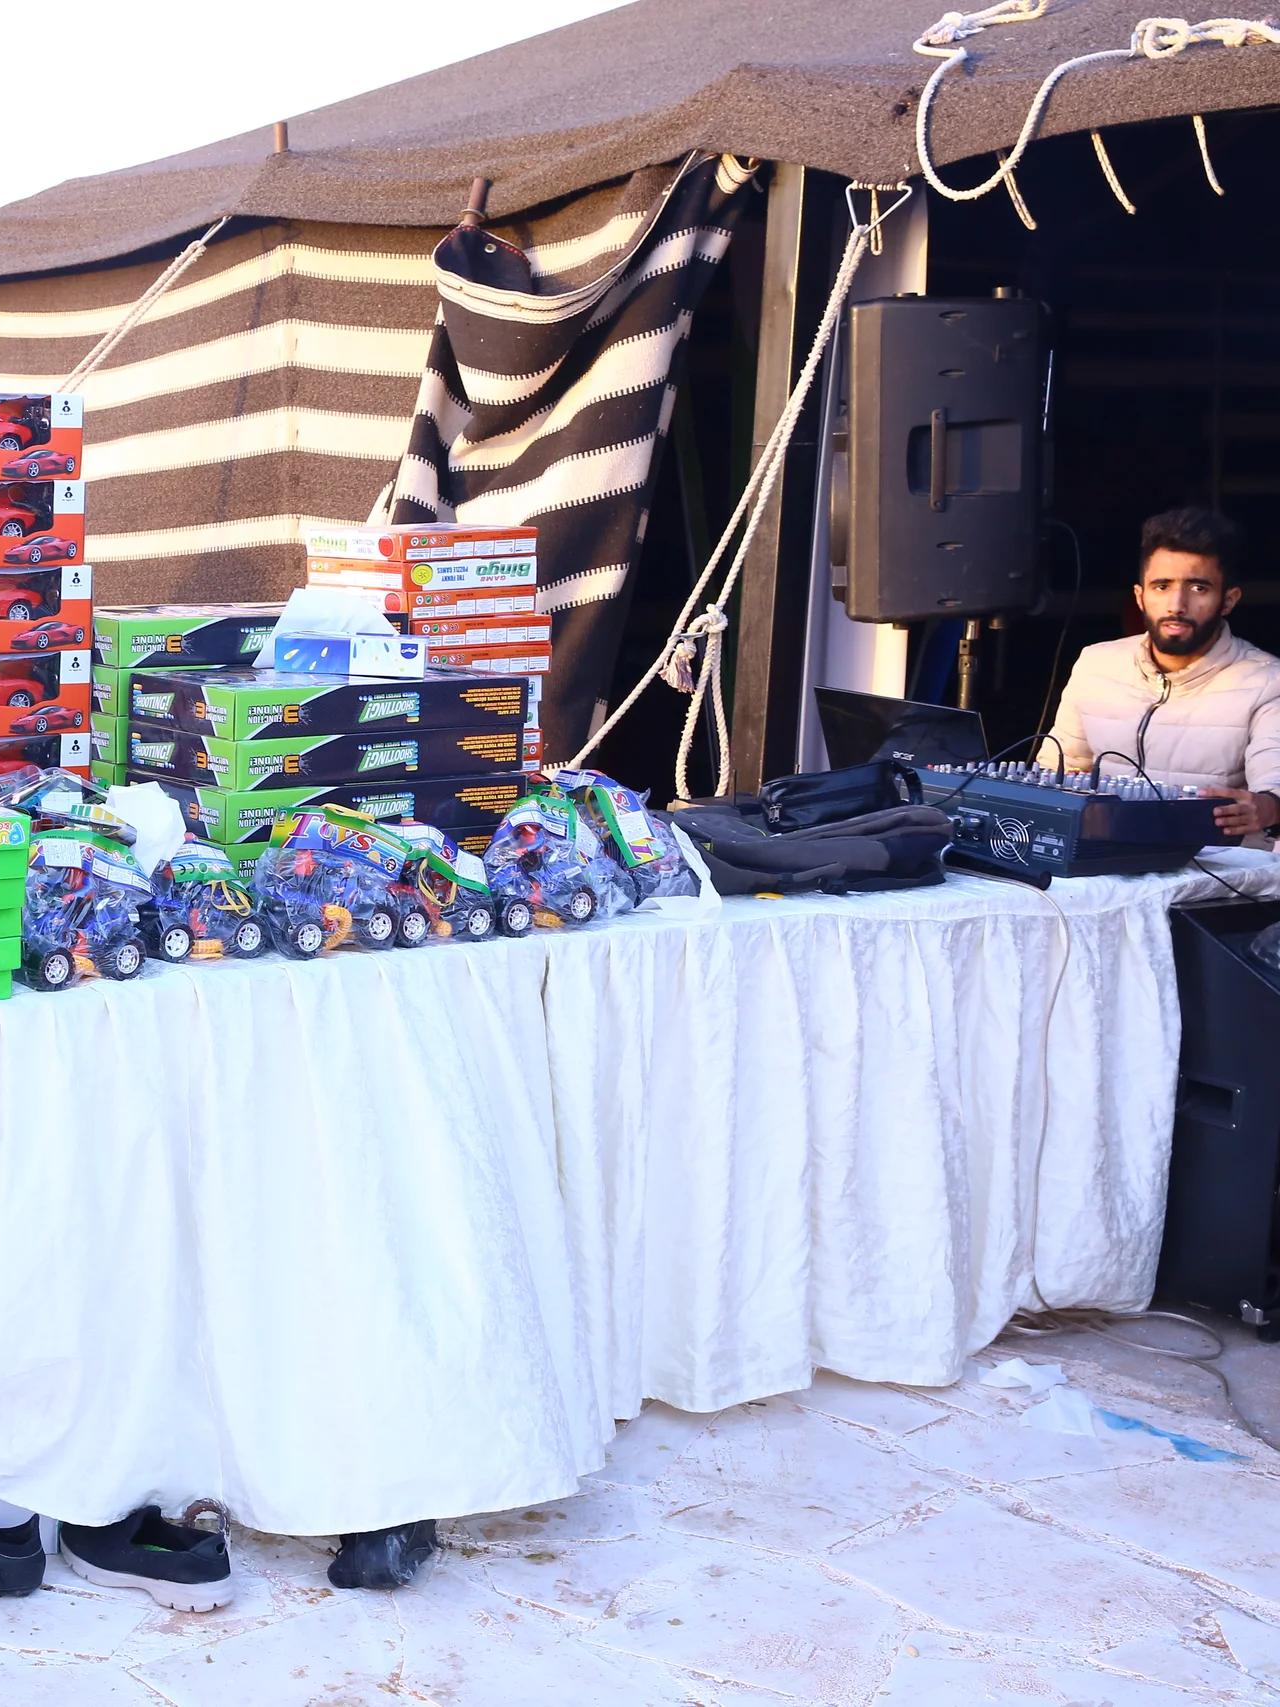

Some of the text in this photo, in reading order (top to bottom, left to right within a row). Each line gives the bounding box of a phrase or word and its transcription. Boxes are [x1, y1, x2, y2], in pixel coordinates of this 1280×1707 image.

[437, 566, 469, 575] PUZZLE GAMES
[476, 561, 531, 577] Bingo
[441, 573, 465, 582] THE FUNNY
[132, 635, 165, 644] IN ONE!
[166, 634, 183, 653] 3
[131, 644, 165, 653] FUNCTION
[136, 695, 171, 711] SHOOTING!
[249, 704, 283, 715] IN ONE!
[366, 699, 415, 718] SHOOTING!
[195, 701, 206, 719] 3
[283, 705, 300, 723] 3
[248, 714, 283, 724] FUNCTION
[135, 744, 171, 760] SHOOTING!
[365, 748, 414, 769] SHOOTING!
[892, 751, 915, 761] acer
[197, 752, 208, 769] 3
[250, 755, 283, 766] IN ONE!
[284, 755, 300, 774] 3
[249, 765, 283, 775] FUNCTION
[189, 802, 199, 820] 3
[239, 808, 274, 819] IN ONE!
[238, 817, 276, 827] FUNCTION
